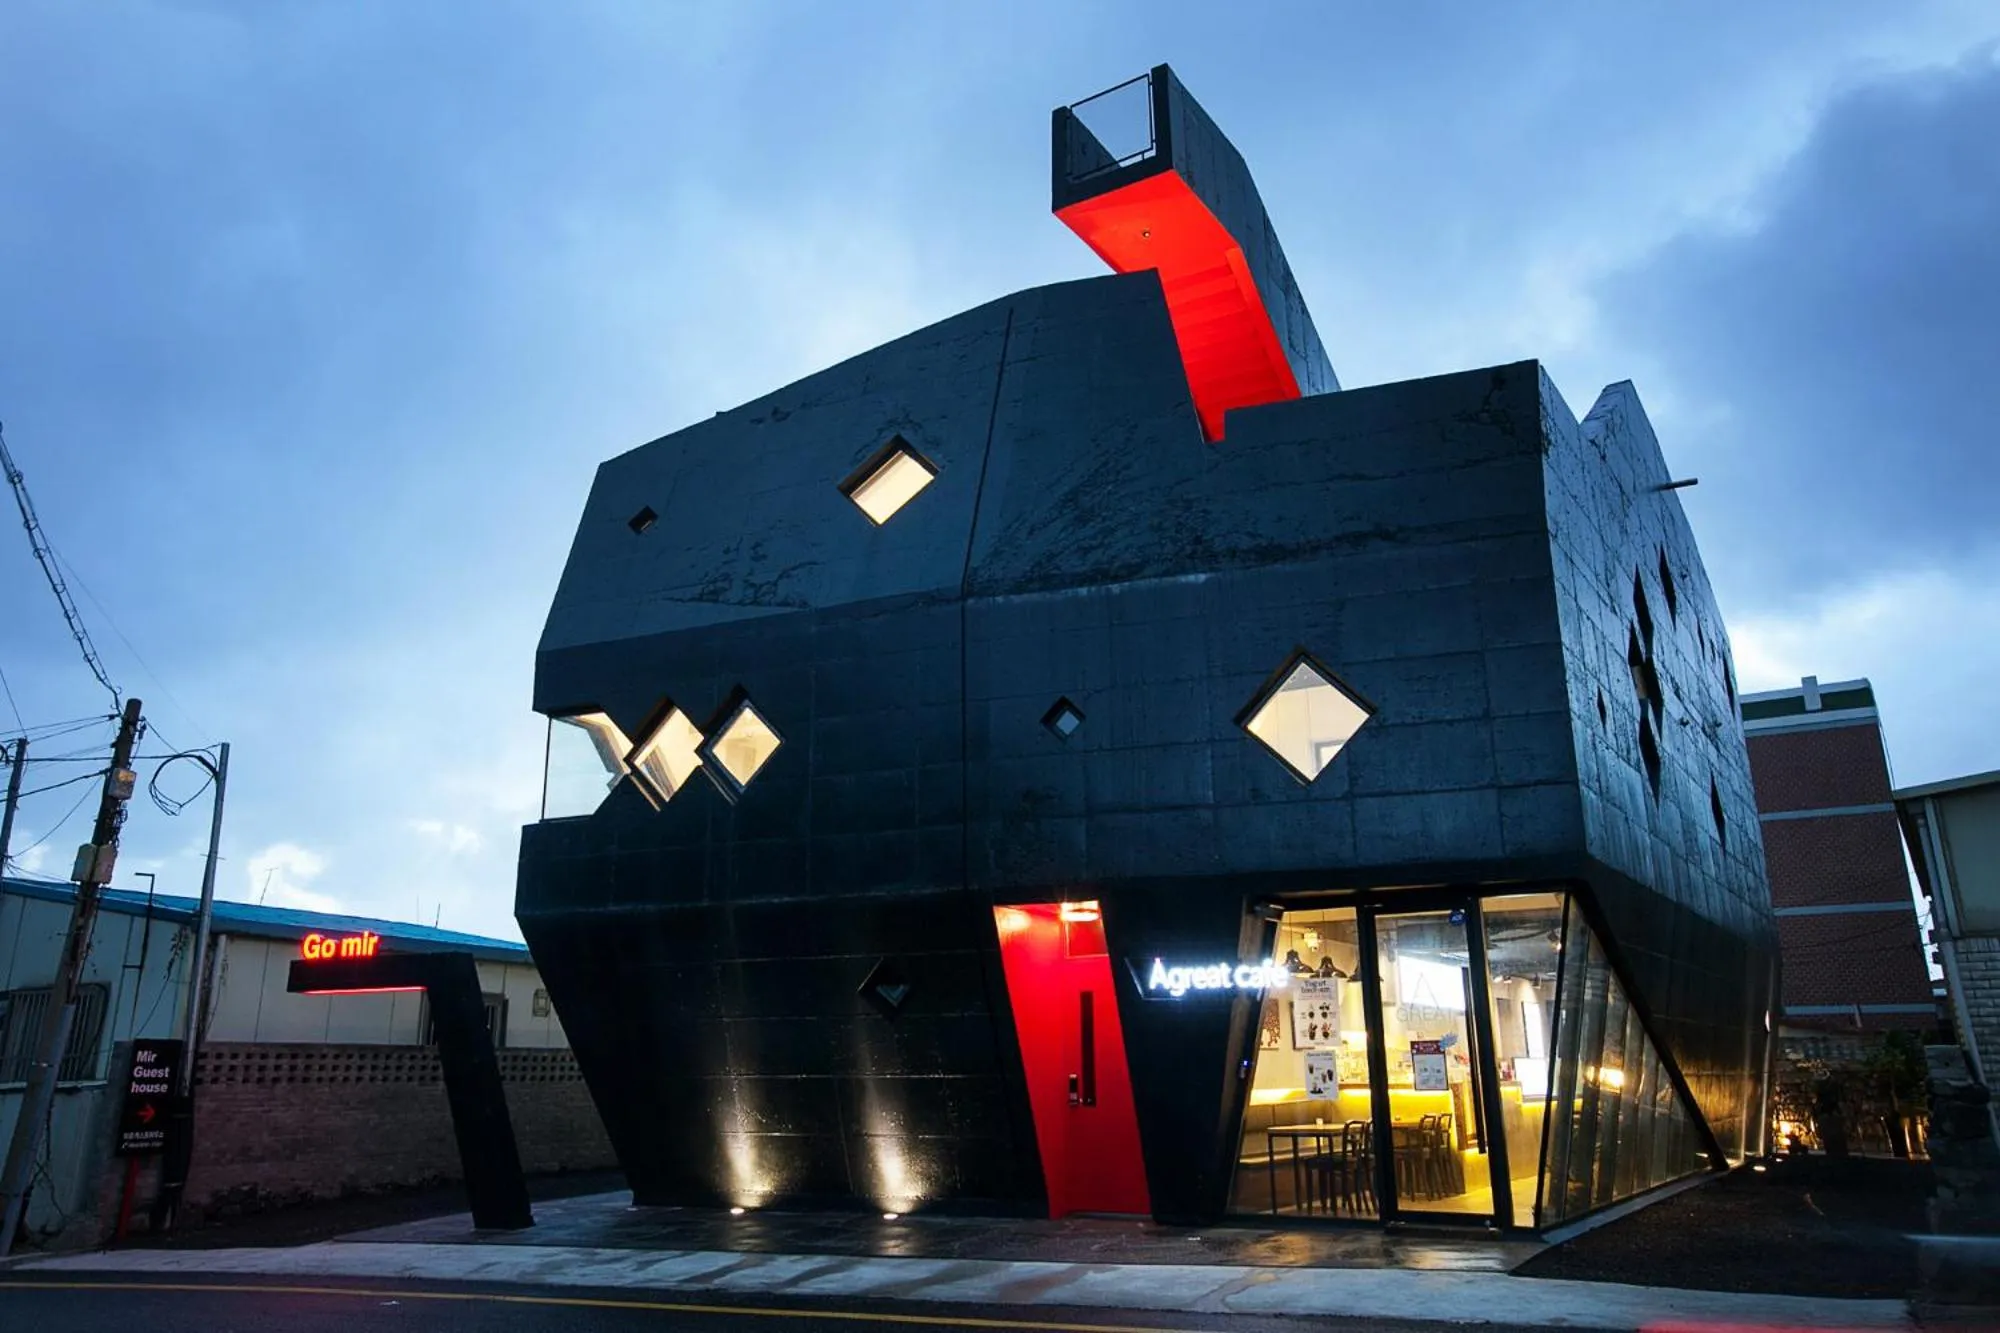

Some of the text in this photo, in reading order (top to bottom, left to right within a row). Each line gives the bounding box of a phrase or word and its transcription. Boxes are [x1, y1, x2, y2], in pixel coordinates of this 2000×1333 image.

[302, 930, 379, 960] Go mir
[136, 1050, 158, 1063] Mir
[133, 1066, 170, 1078] Guest
[130, 1081, 169, 1094] house
